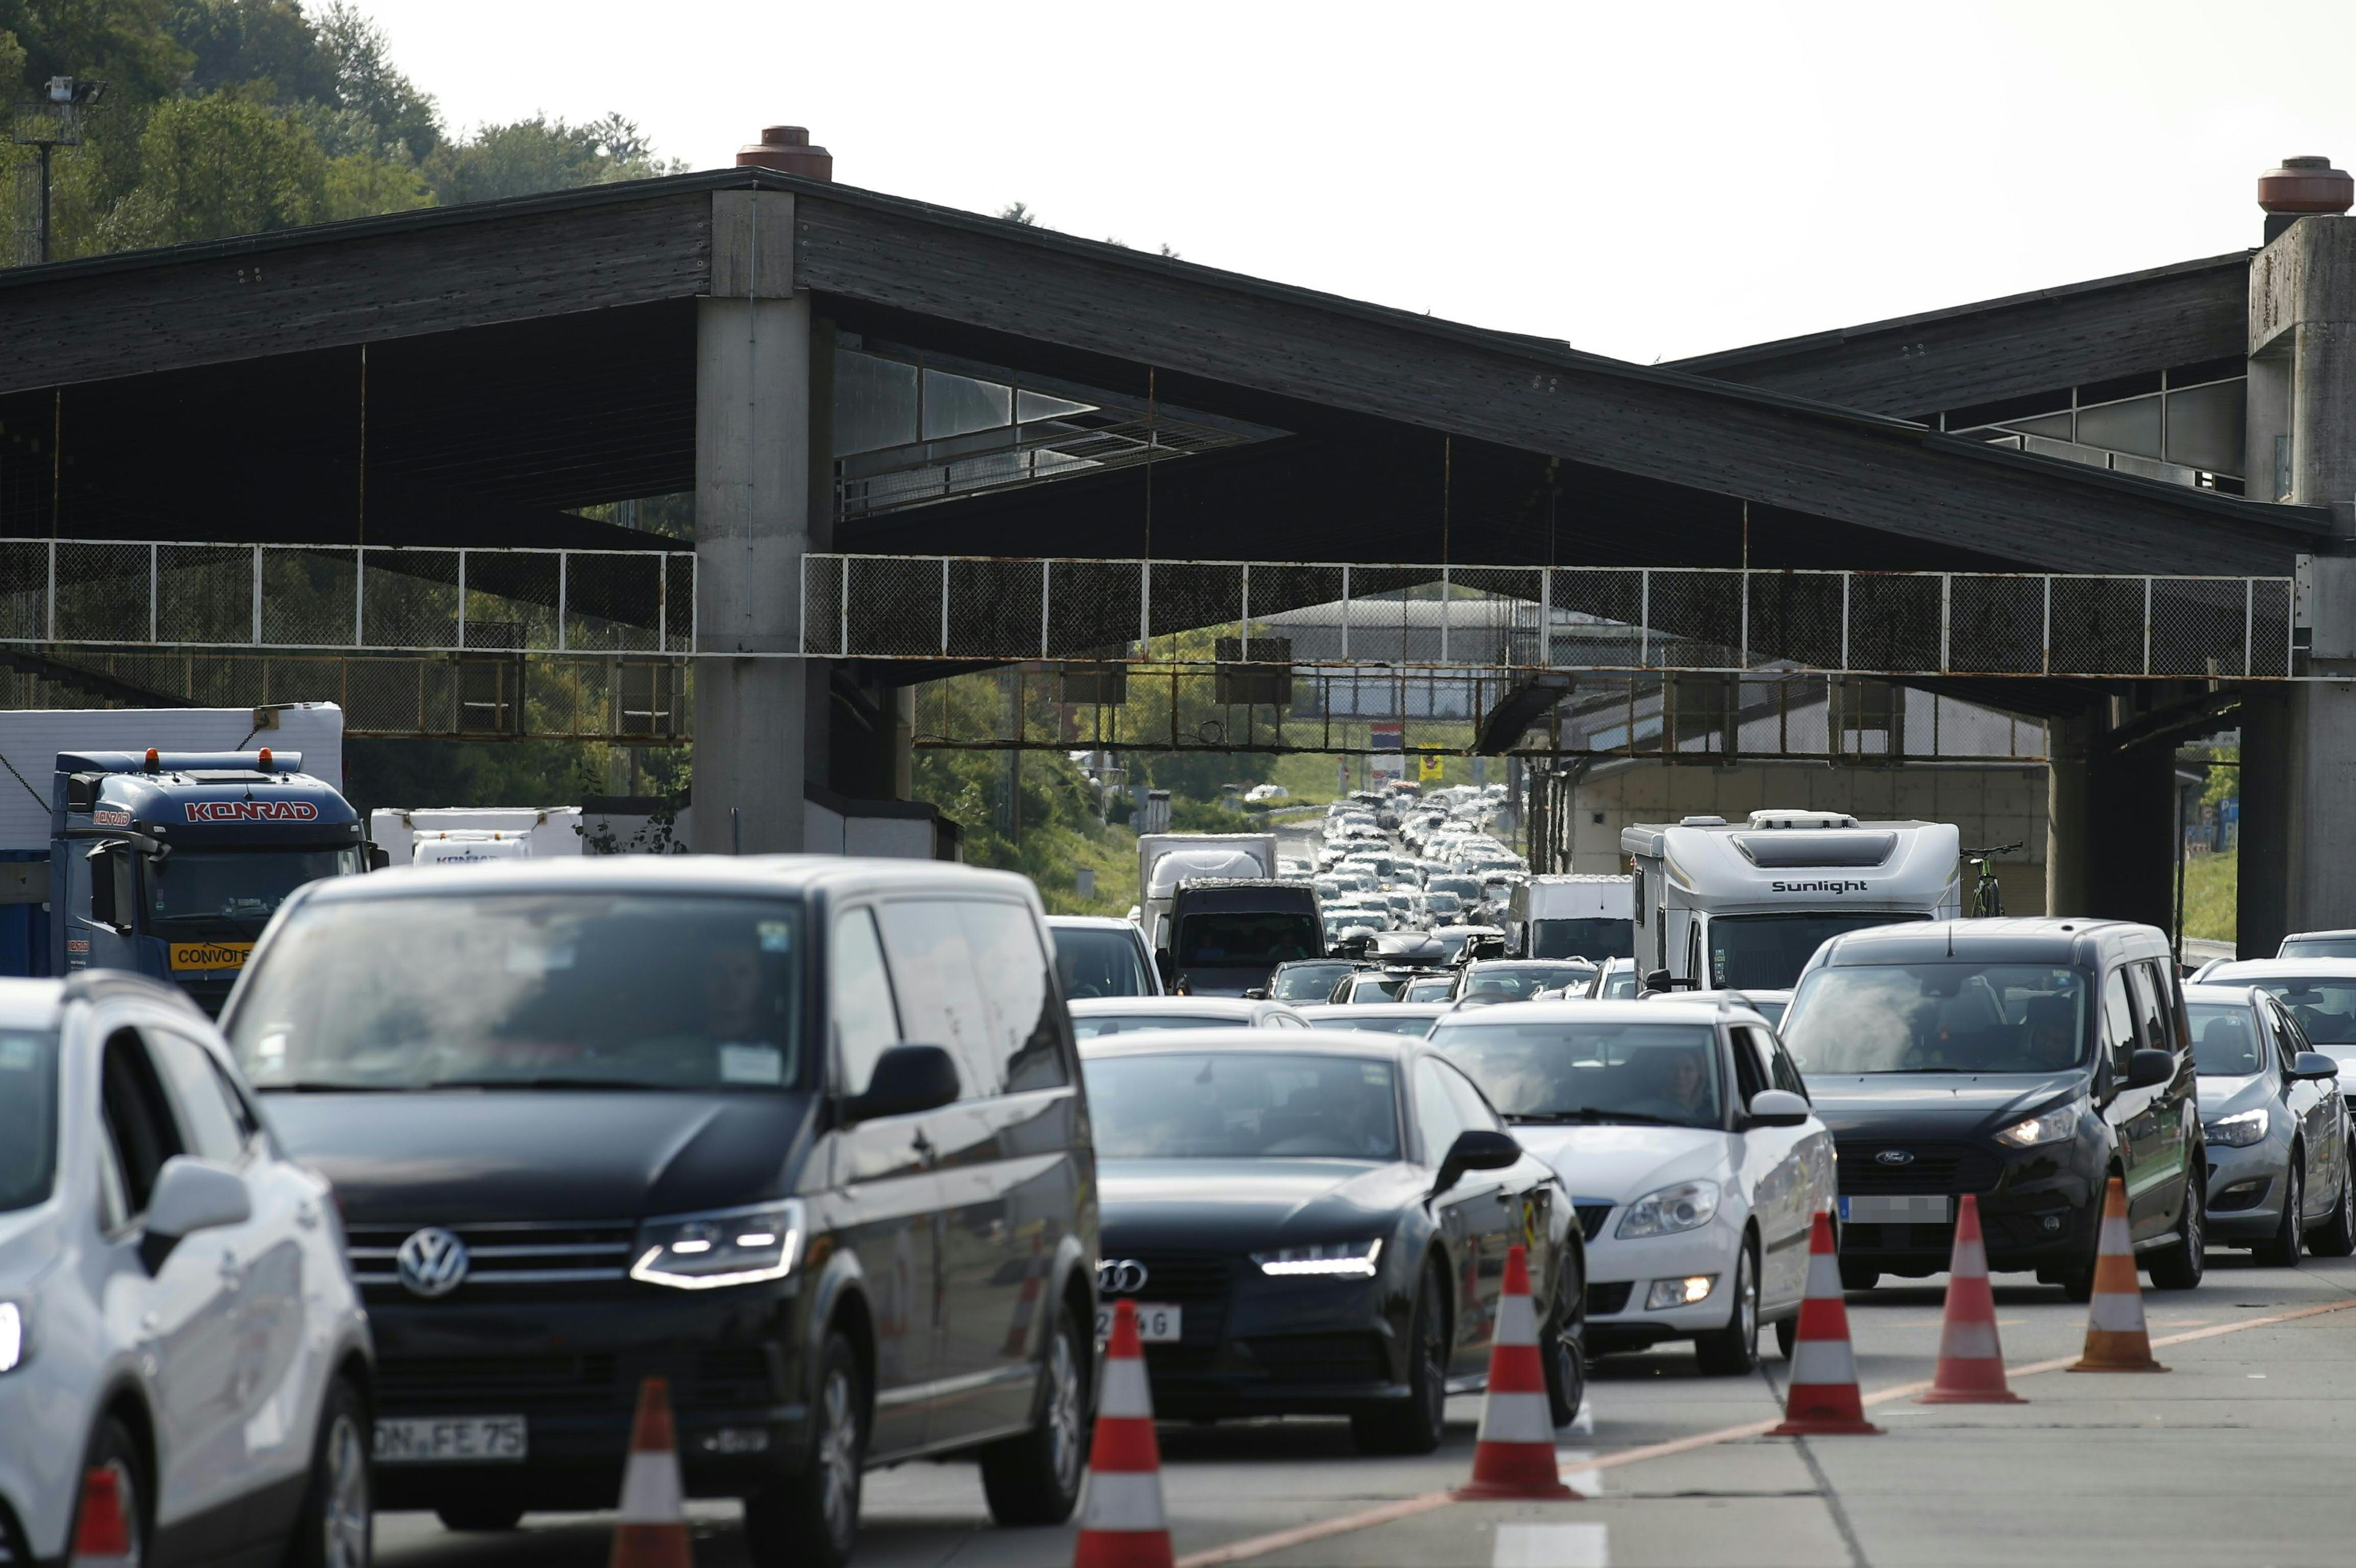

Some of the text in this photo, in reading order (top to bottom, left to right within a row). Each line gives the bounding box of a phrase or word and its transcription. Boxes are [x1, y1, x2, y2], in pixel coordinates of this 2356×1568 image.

[94, 810, 130, 826] KONRAD
[184, 802, 318, 822] KONRAD
[1772, 881, 1868, 895] Sunlight
[178, 950, 237, 963] CONVOI
